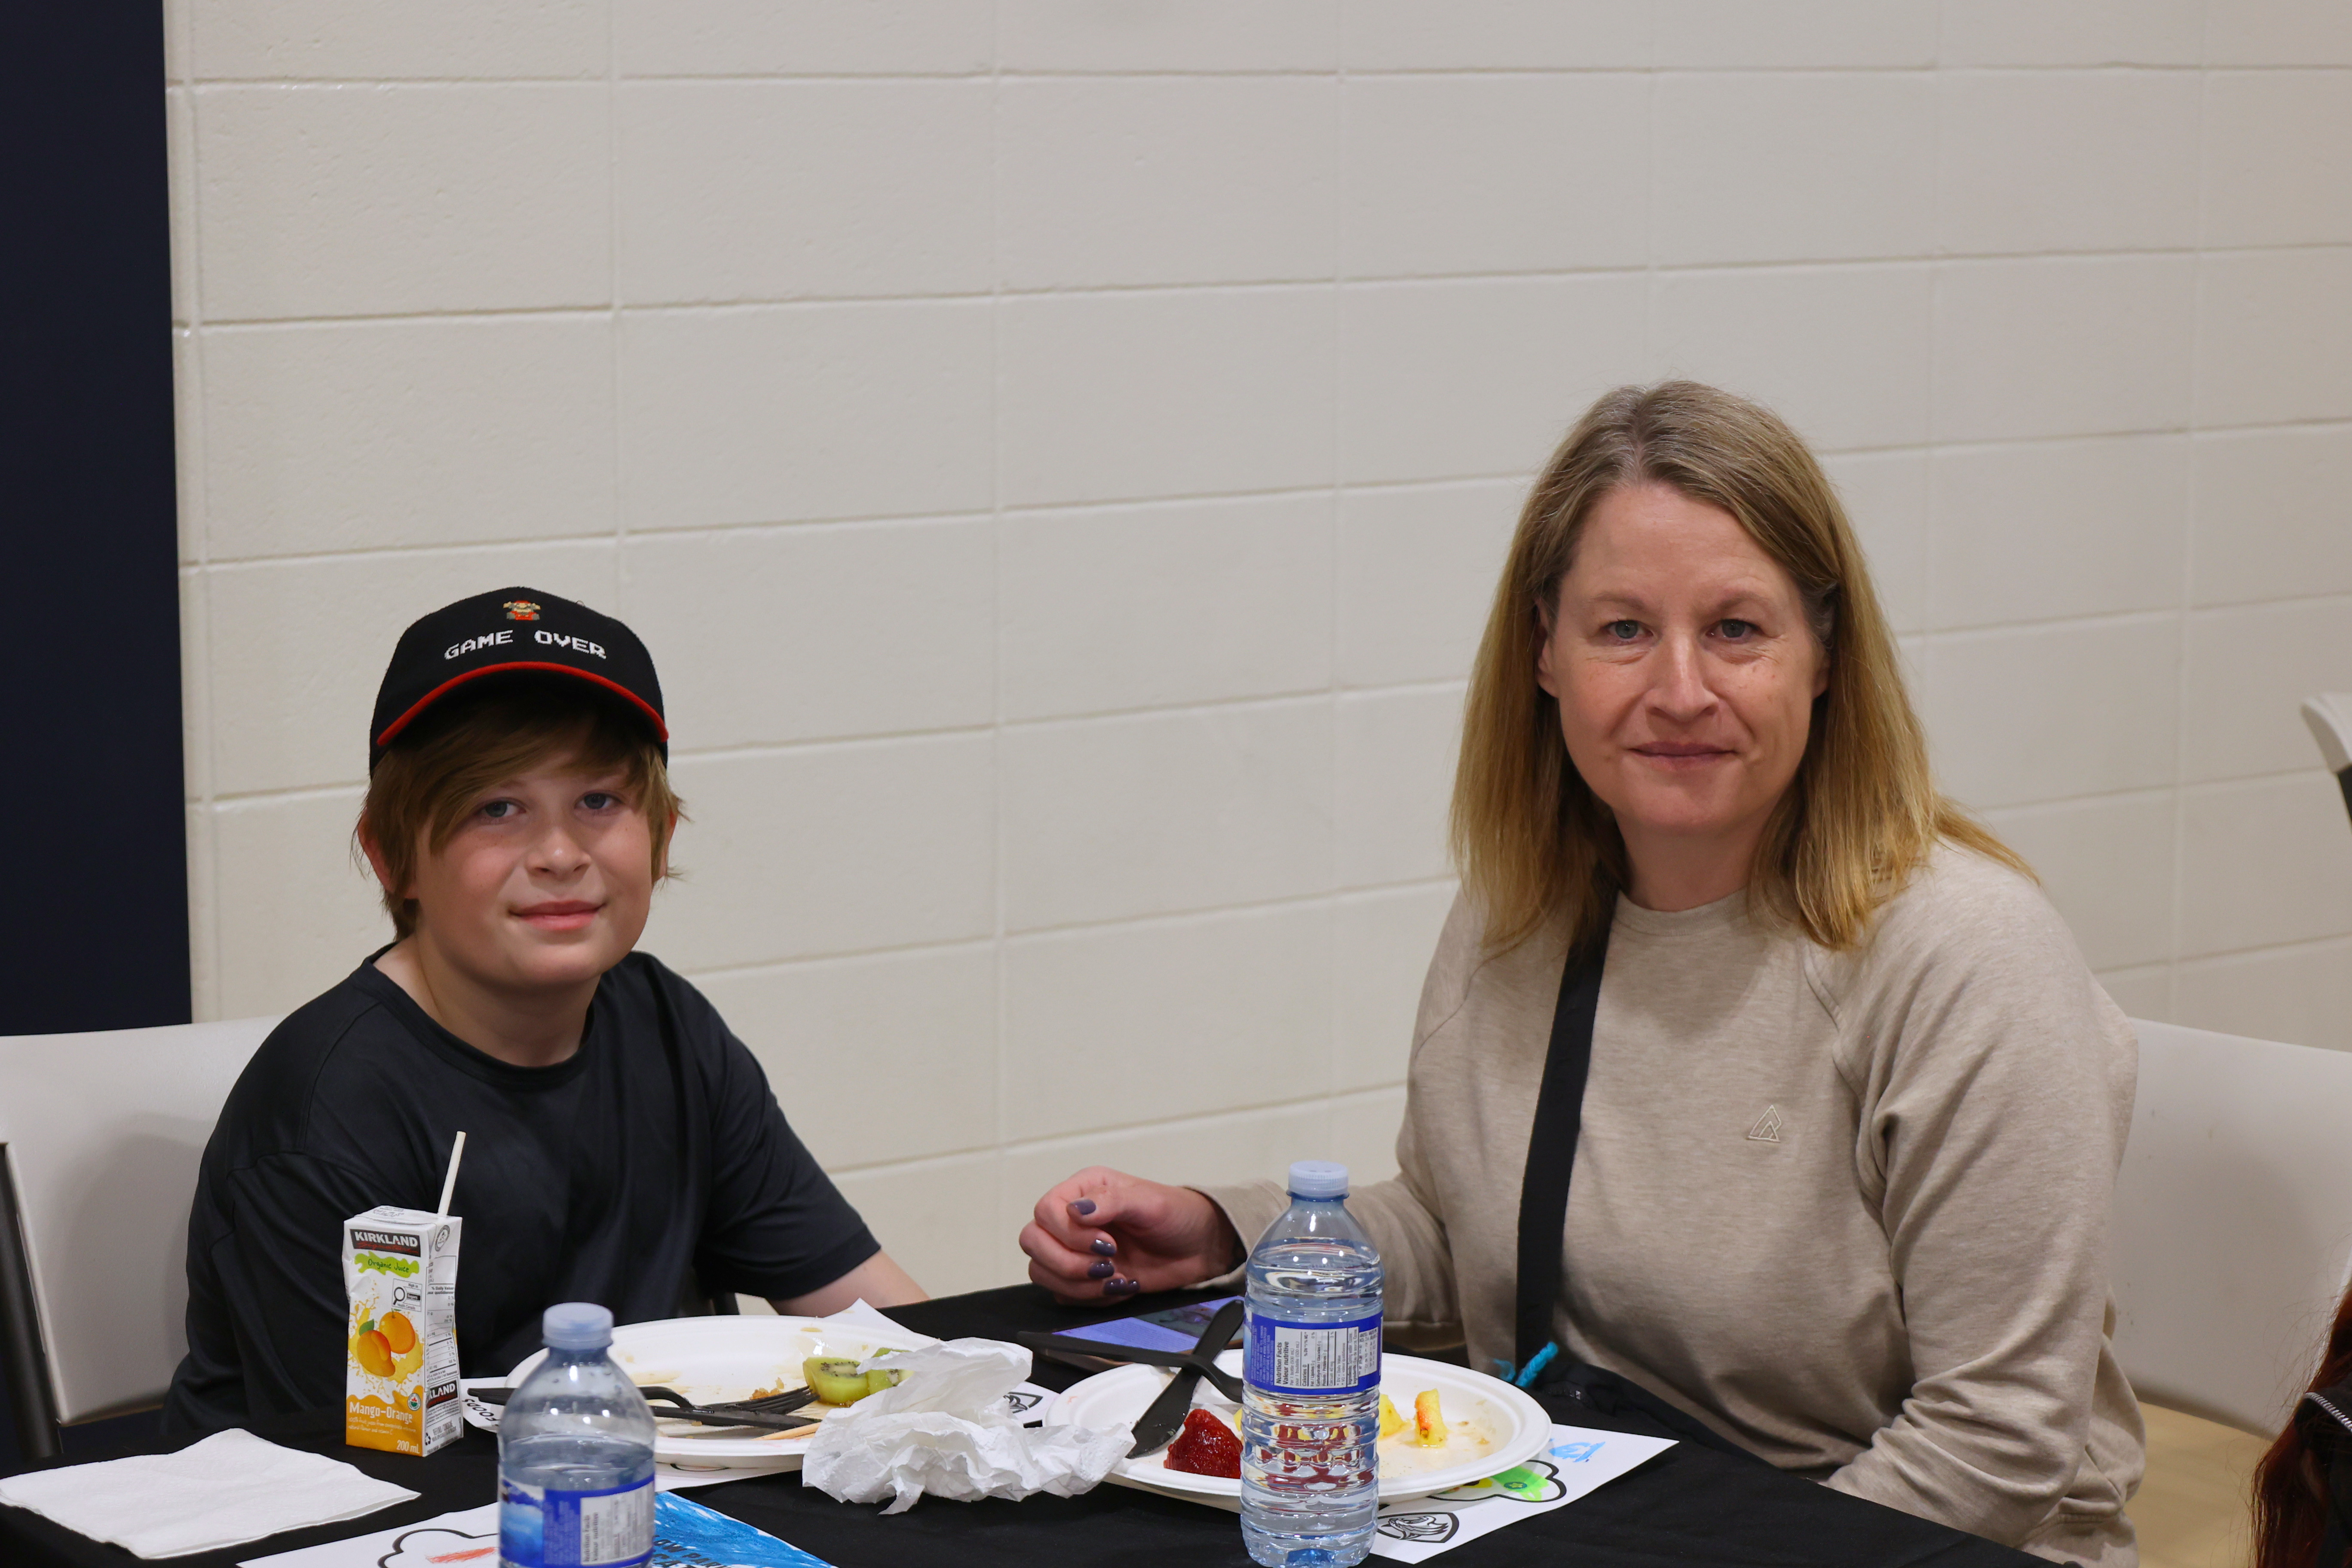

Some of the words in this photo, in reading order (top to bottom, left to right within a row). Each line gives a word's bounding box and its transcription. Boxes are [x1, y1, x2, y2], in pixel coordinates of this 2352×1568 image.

[444, 630, 513, 659] GAME
[534, 630, 606, 659] OVER
[354, 1231, 418, 1247] KIRKLAND
[368, 1259, 391, 1269] Organic
[394, 1262, 409, 1272] Juice
[349, 1401, 413, 1424] Mango-Orange
[397, 1440, 409, 1451] 200
[410, 1444, 420, 1454] mL
